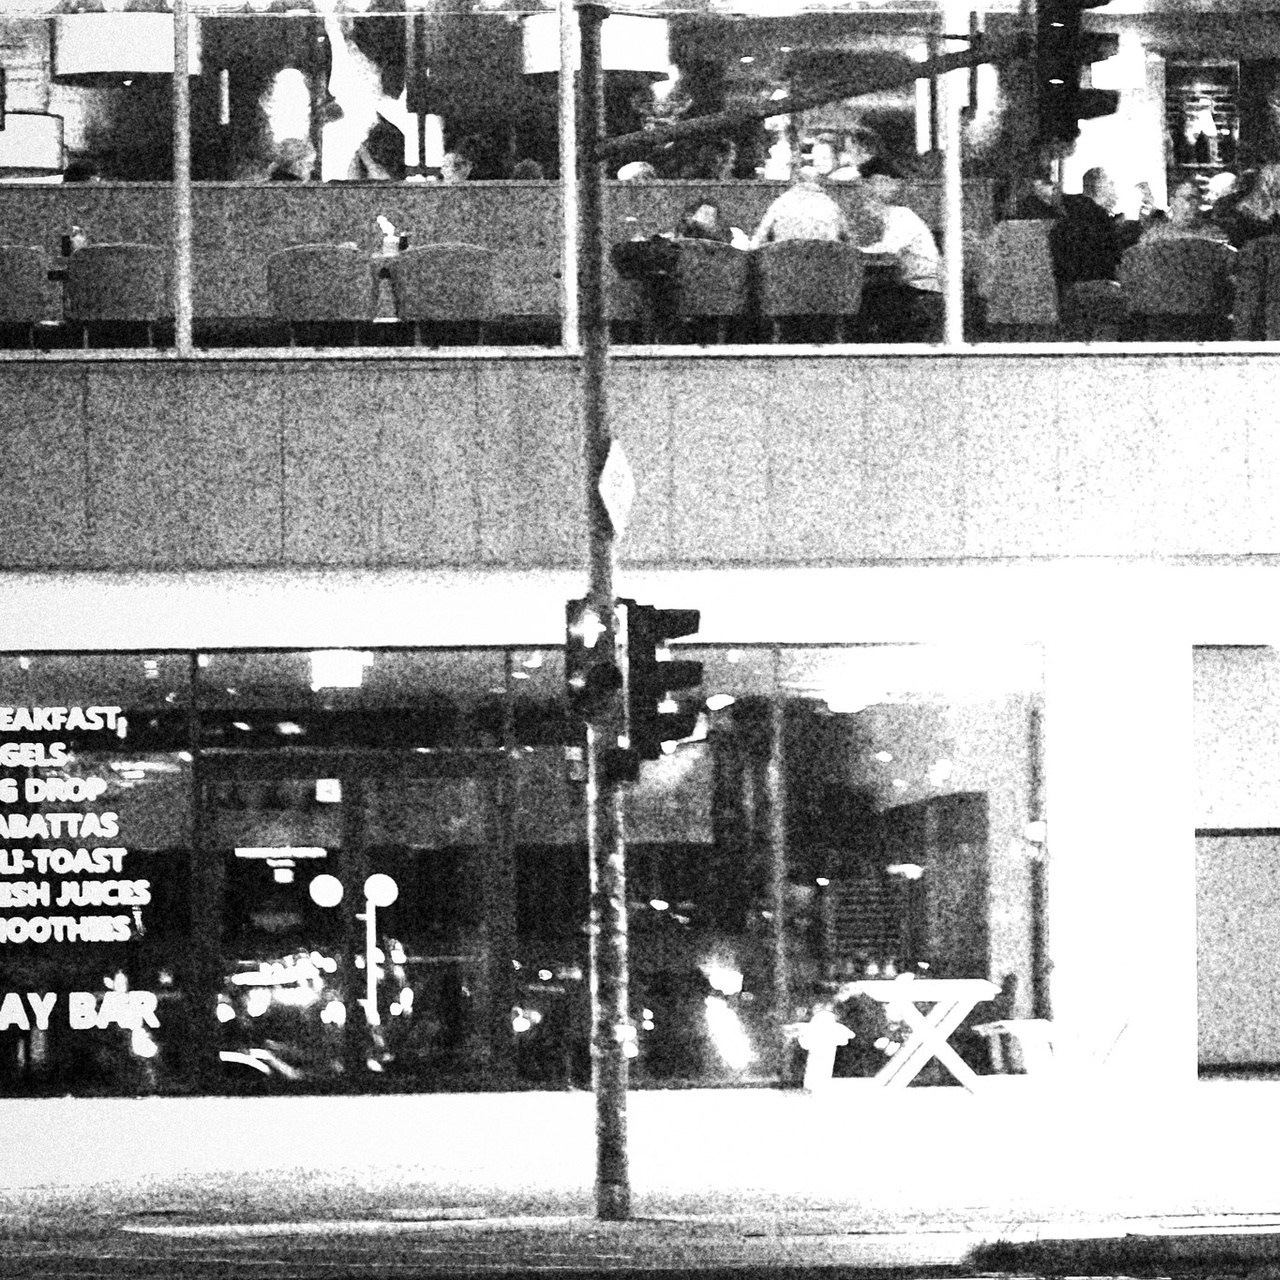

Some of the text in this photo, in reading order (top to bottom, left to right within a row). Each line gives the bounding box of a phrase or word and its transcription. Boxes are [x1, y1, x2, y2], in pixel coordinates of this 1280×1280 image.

[0, 741, 68, 767] GELS
[25, 776, 107, 803] DROP
[56, 879, 151, 907] JUICES
[0, 915, 131, 943] OOTHIES
[69, 990, 160, 1030] BAR
